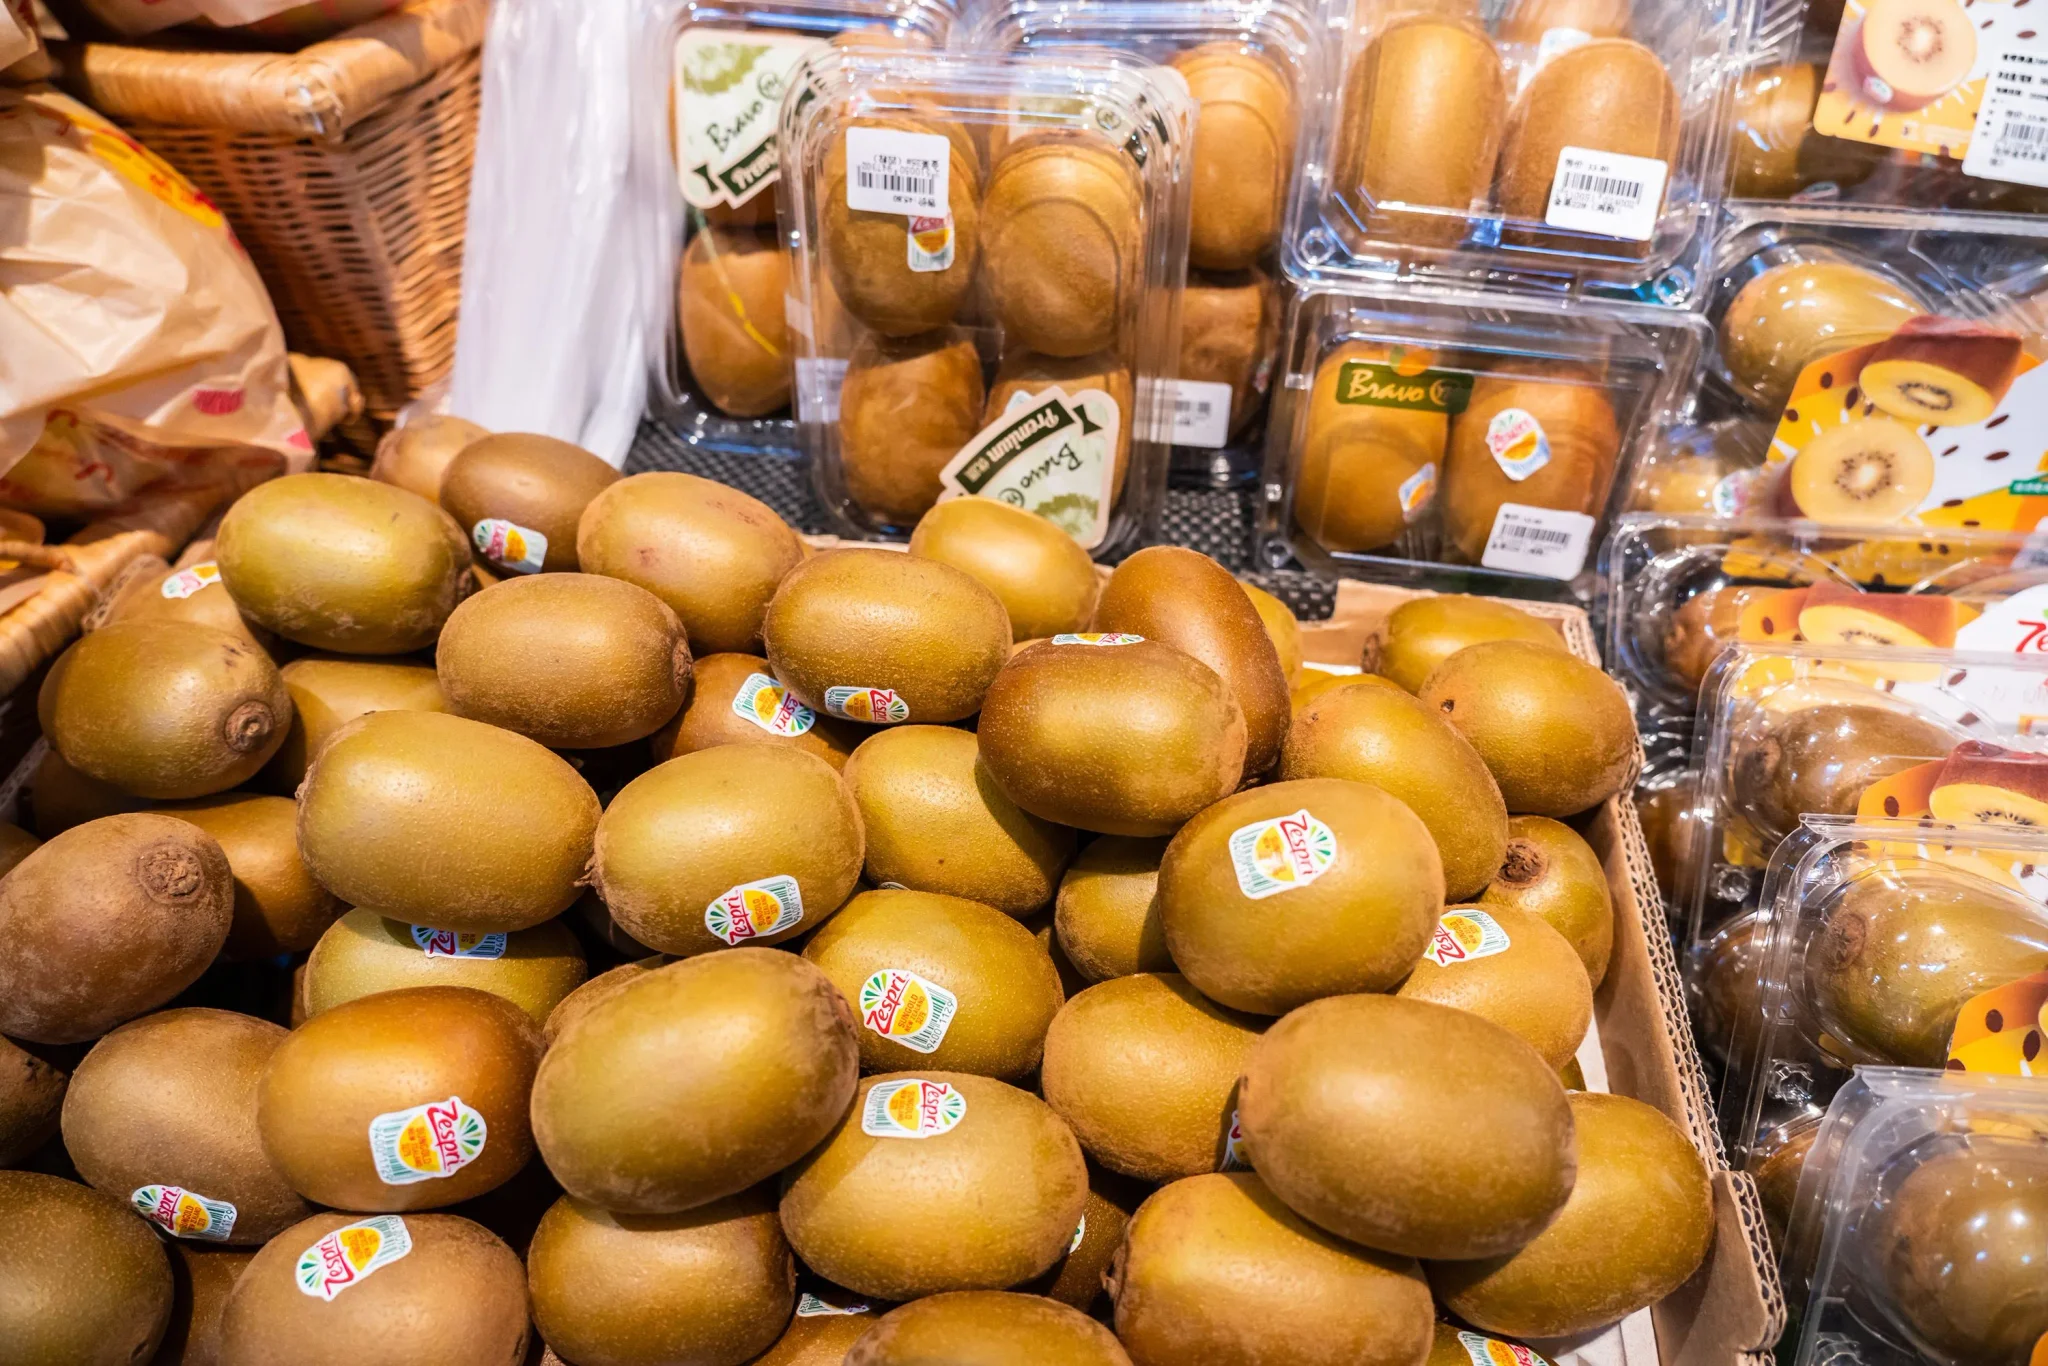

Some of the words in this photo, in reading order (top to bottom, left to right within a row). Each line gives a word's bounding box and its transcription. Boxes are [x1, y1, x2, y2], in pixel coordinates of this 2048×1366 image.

[706, 100, 763, 153] Bravo
[1347, 369, 1425, 402] Bravo
[986, 408, 1060, 463] Premium
[1020, 443, 1083, 489] Bravo
[1280, 814, 1318, 875] Zespri
[723, 892, 756, 944] Zespri
[1434, 925, 1465, 963] Zesp
[866, 972, 910, 1035] Zespri
[898, 994, 918, 1028] SUNGOLD
[939, 1000, 955, 1024] 1129
[921, 1082, 948, 1130] Zespri
[427, 1101, 466, 1167] Zespri
[149, 1187, 181, 1231] Zespri
[315, 1234, 354, 1296] Zespri
